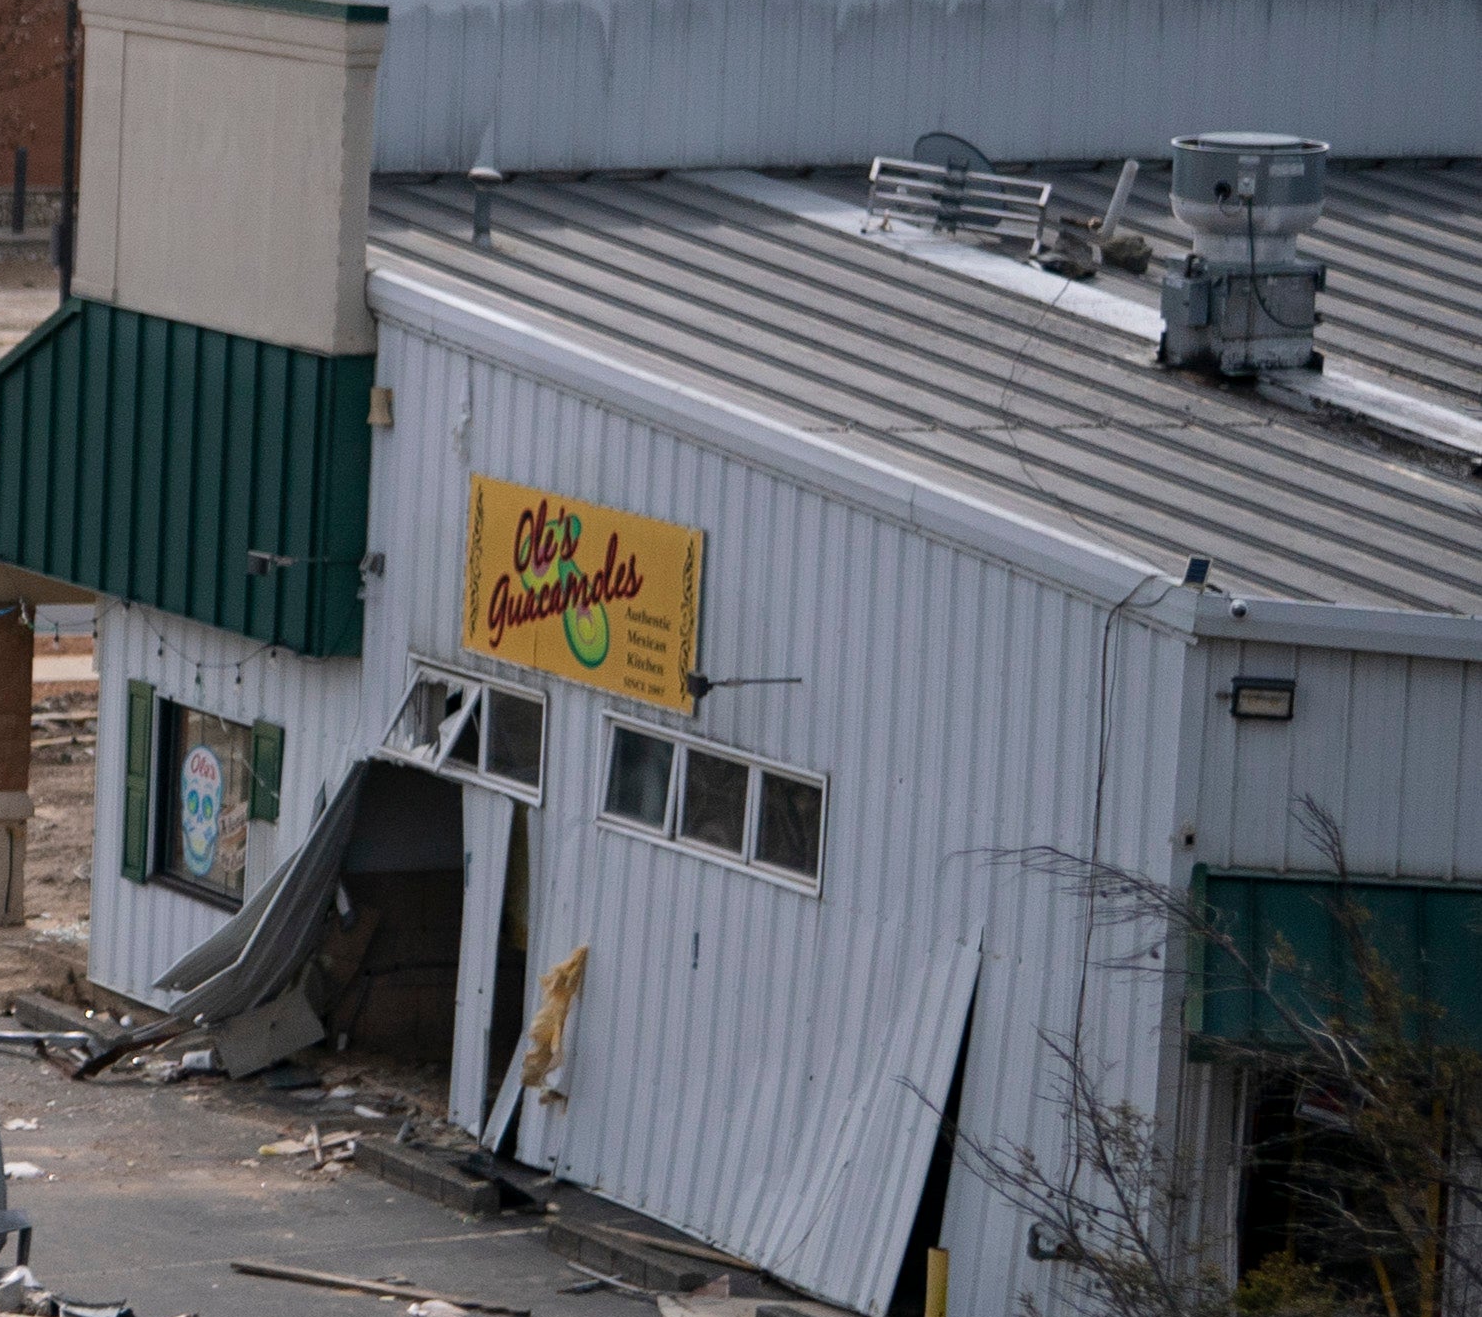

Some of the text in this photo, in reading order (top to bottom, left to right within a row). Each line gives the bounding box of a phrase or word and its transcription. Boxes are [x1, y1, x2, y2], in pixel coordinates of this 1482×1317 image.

[488, 532, 643, 649] Guacamoles
[625, 606, 672, 632] Authentic
[626, 629, 667, 653] Mexican
[626, 652, 664, 676] Kitchen
